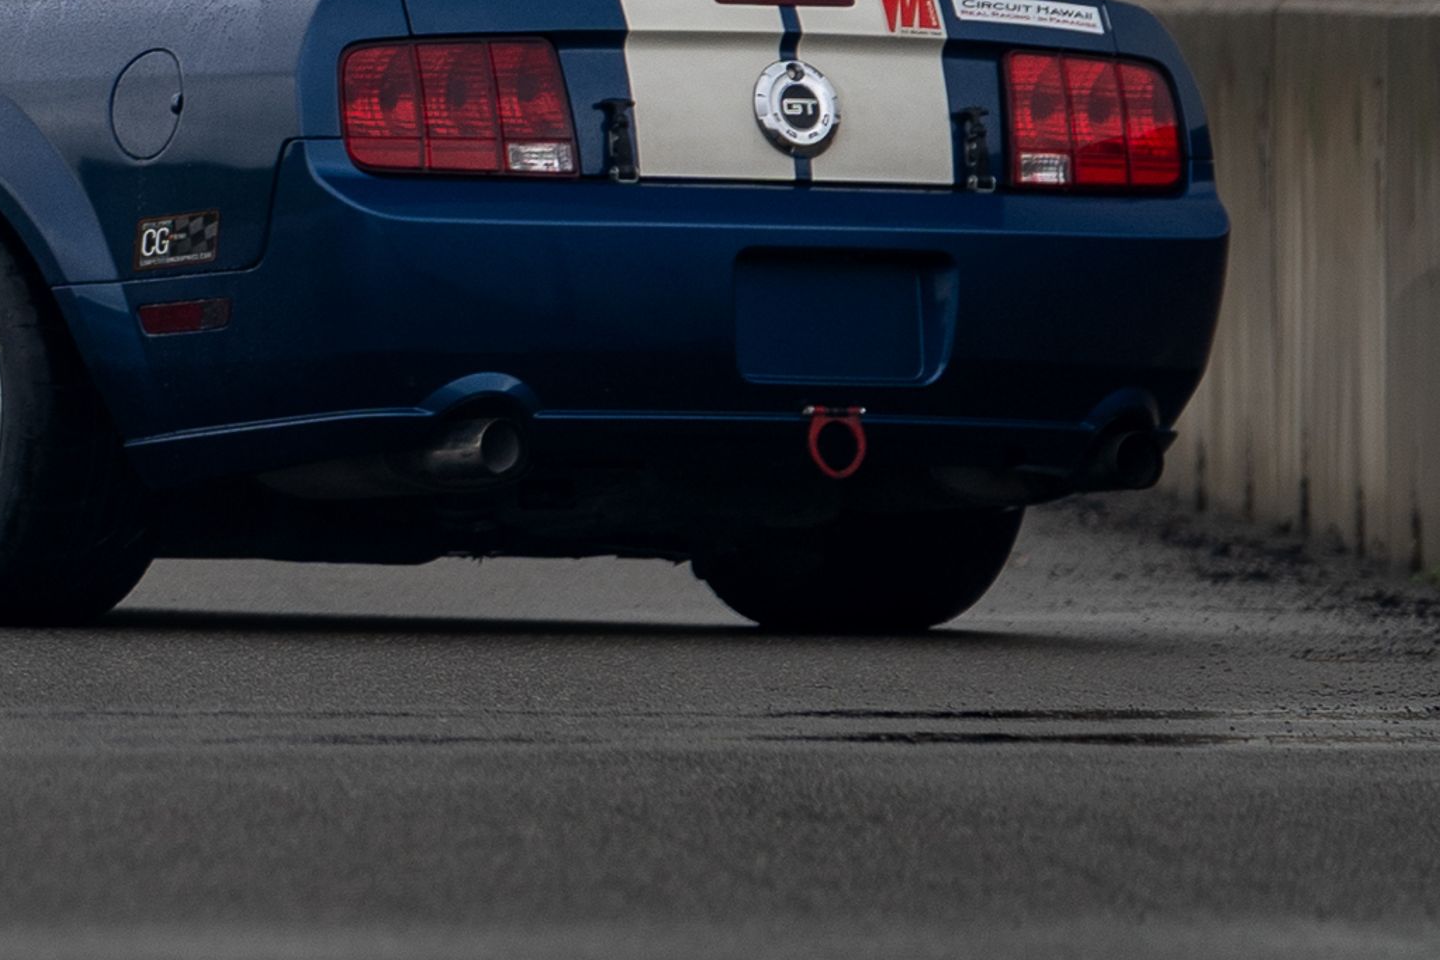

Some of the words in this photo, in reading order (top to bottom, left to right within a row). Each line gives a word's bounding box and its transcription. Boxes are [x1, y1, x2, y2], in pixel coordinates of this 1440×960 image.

[1037, 3, 1093, 21] HAWAII
[782, 98, 819, 116] GT
[141, 226, 170, 257] CG
